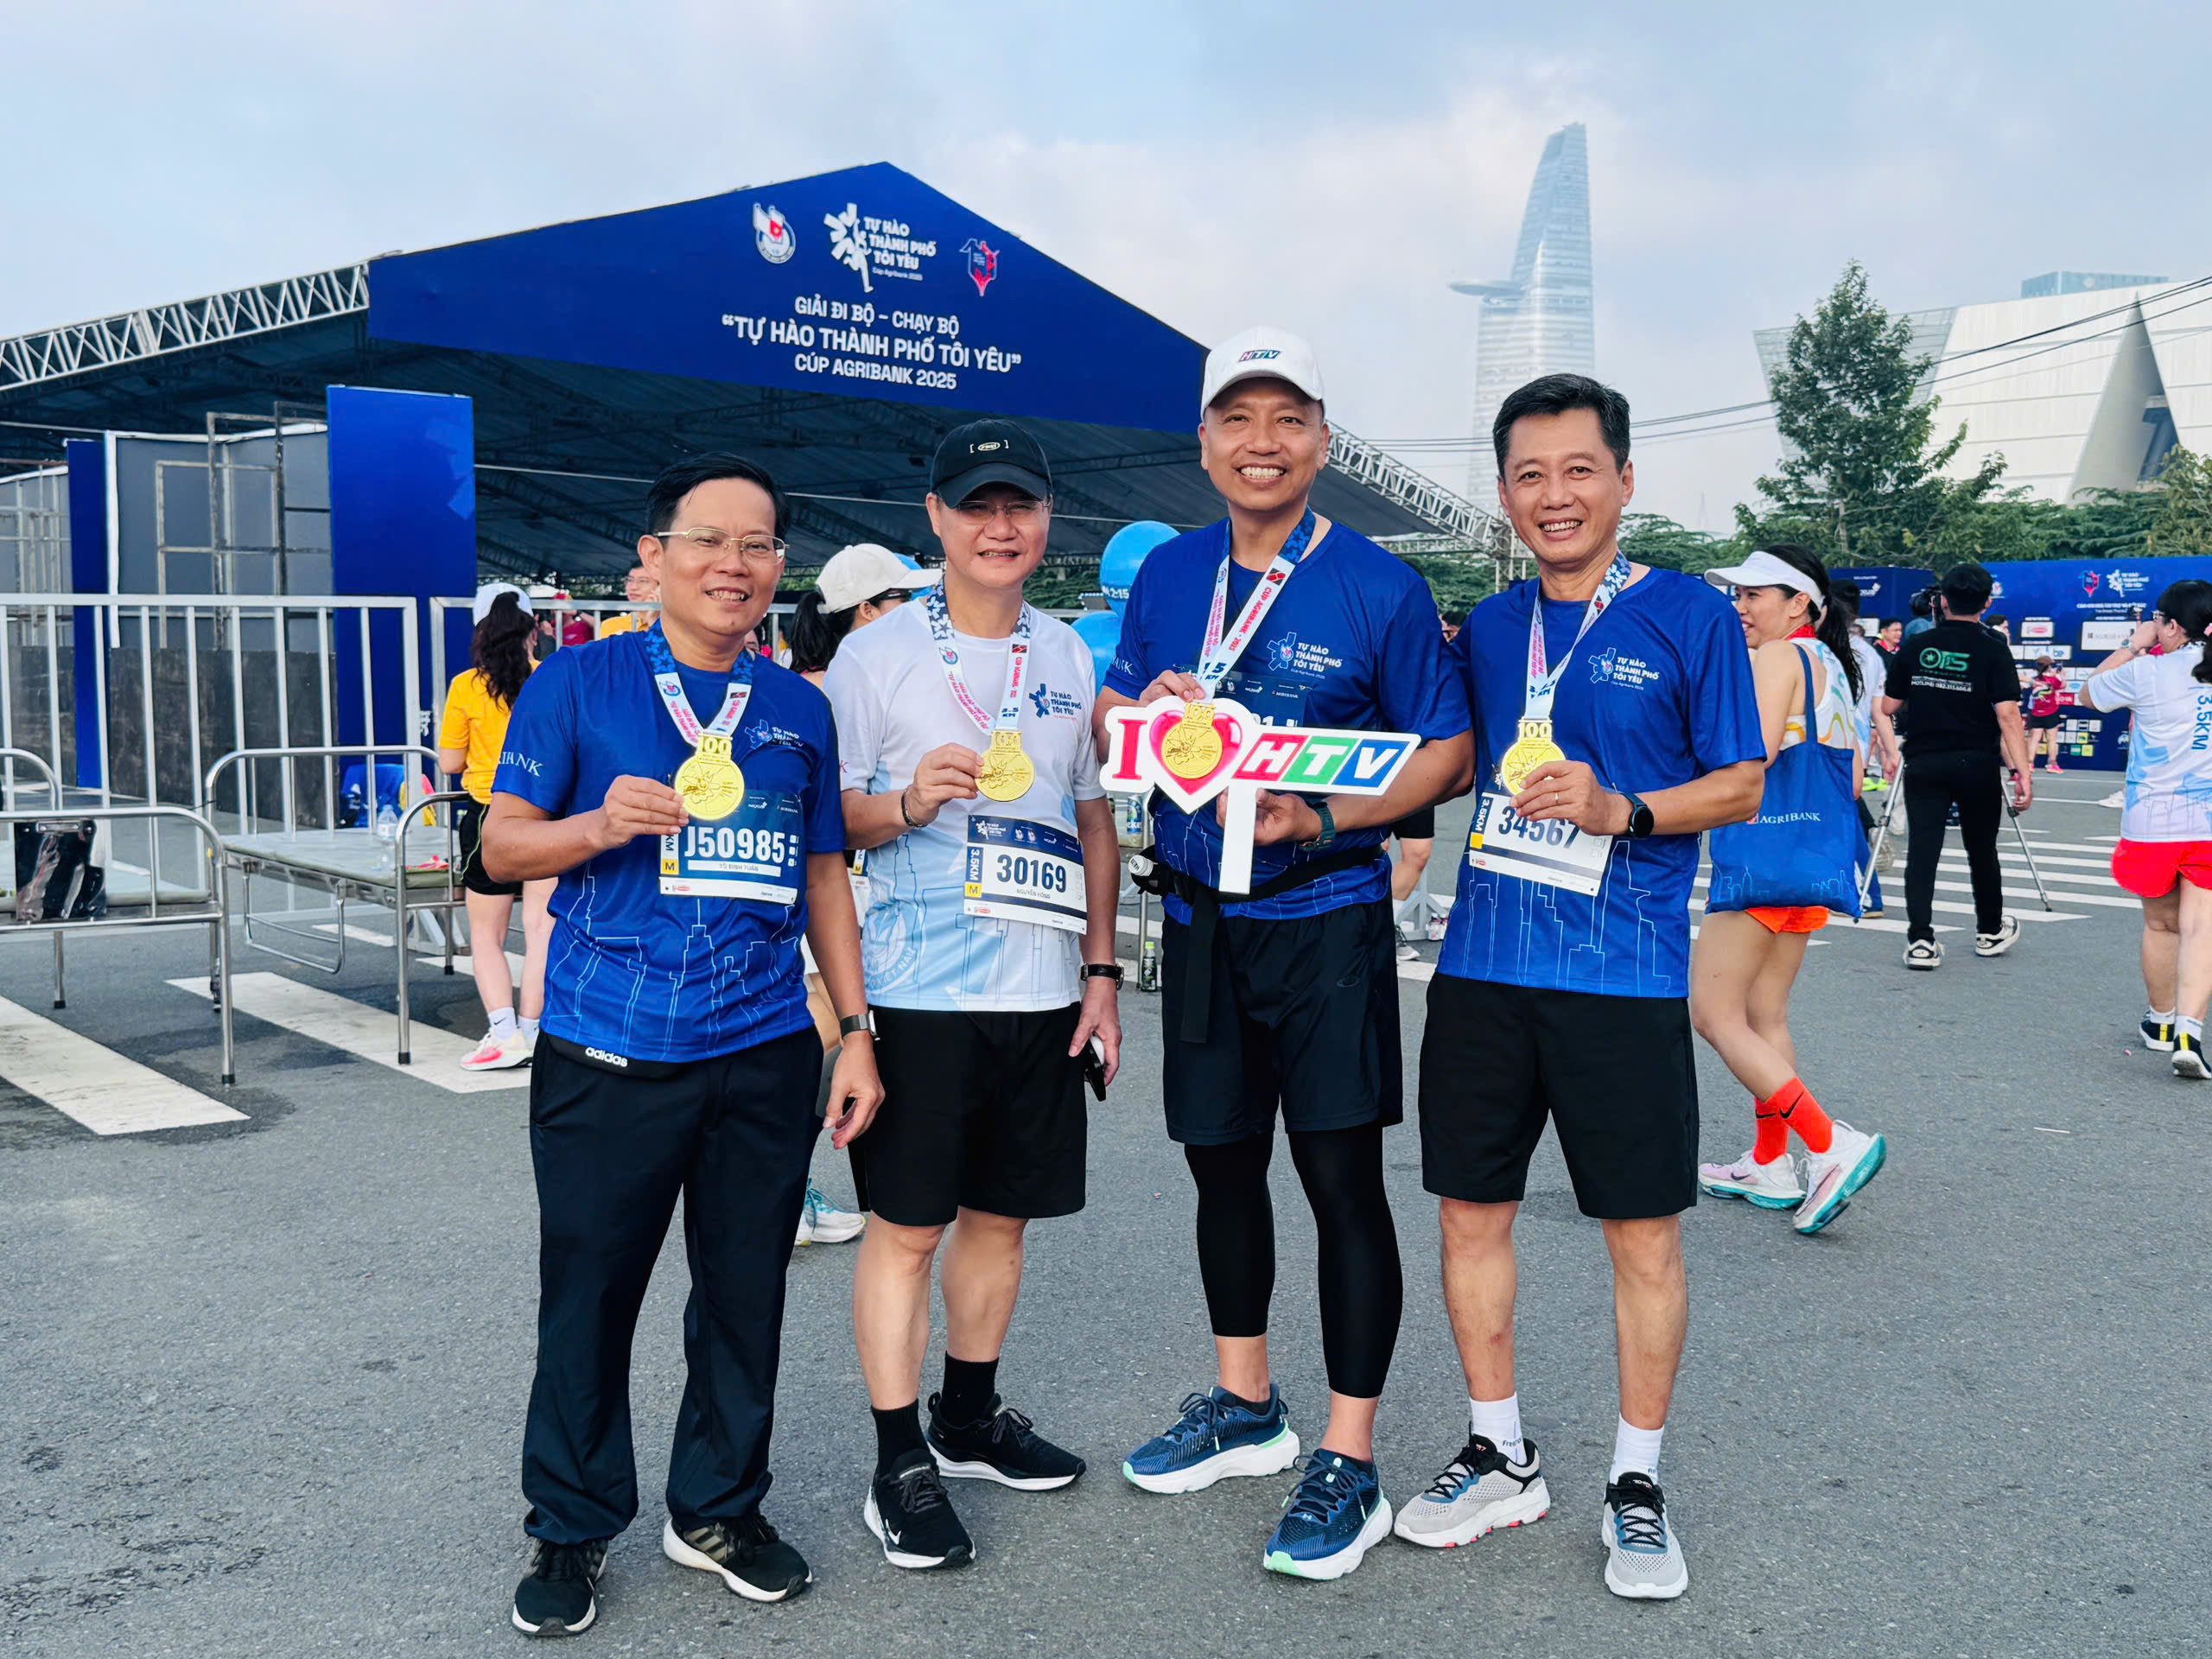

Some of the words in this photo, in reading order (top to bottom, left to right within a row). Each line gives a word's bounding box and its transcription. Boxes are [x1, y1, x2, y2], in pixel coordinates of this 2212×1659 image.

[873, 249, 894, 266] TÔI
[794, 293, 828, 318] GIẢI
[830, 301, 848, 321] ĐI
[851, 302, 875, 327] BỘ
[892, 310, 935, 334] CHẠY
[937, 315, 960, 340] BỘ
[770, 318, 815, 347] HÀO
[818, 326, 889, 358] THÀNH
[893, 335, 935, 363] PHỐ
[938, 341, 969, 368] TÔI
[794, 351, 830, 373] CÚP
[831, 358, 913, 385] AGRIBANK
[916, 369, 957, 390] 2025
[1517, 722, 1552, 740] 100
[2191, 694, 2212, 750] 3.5KM
[1112, 719, 1147, 780] I
[1242, 740, 1400, 780] HTV
[1474, 798, 1491, 832] 3.5KM
[1498, 805, 1580, 849] 34567
[1759, 812, 1821, 823] AGRIBANK
[684, 826, 785, 864] J50985
[664, 861, 676, 871] M
[969, 848, 981, 880] 3.5KM
[996, 854, 1067, 893] 30169
[969, 885, 978, 894] M
[585, 1046, 628, 1067] adidas
